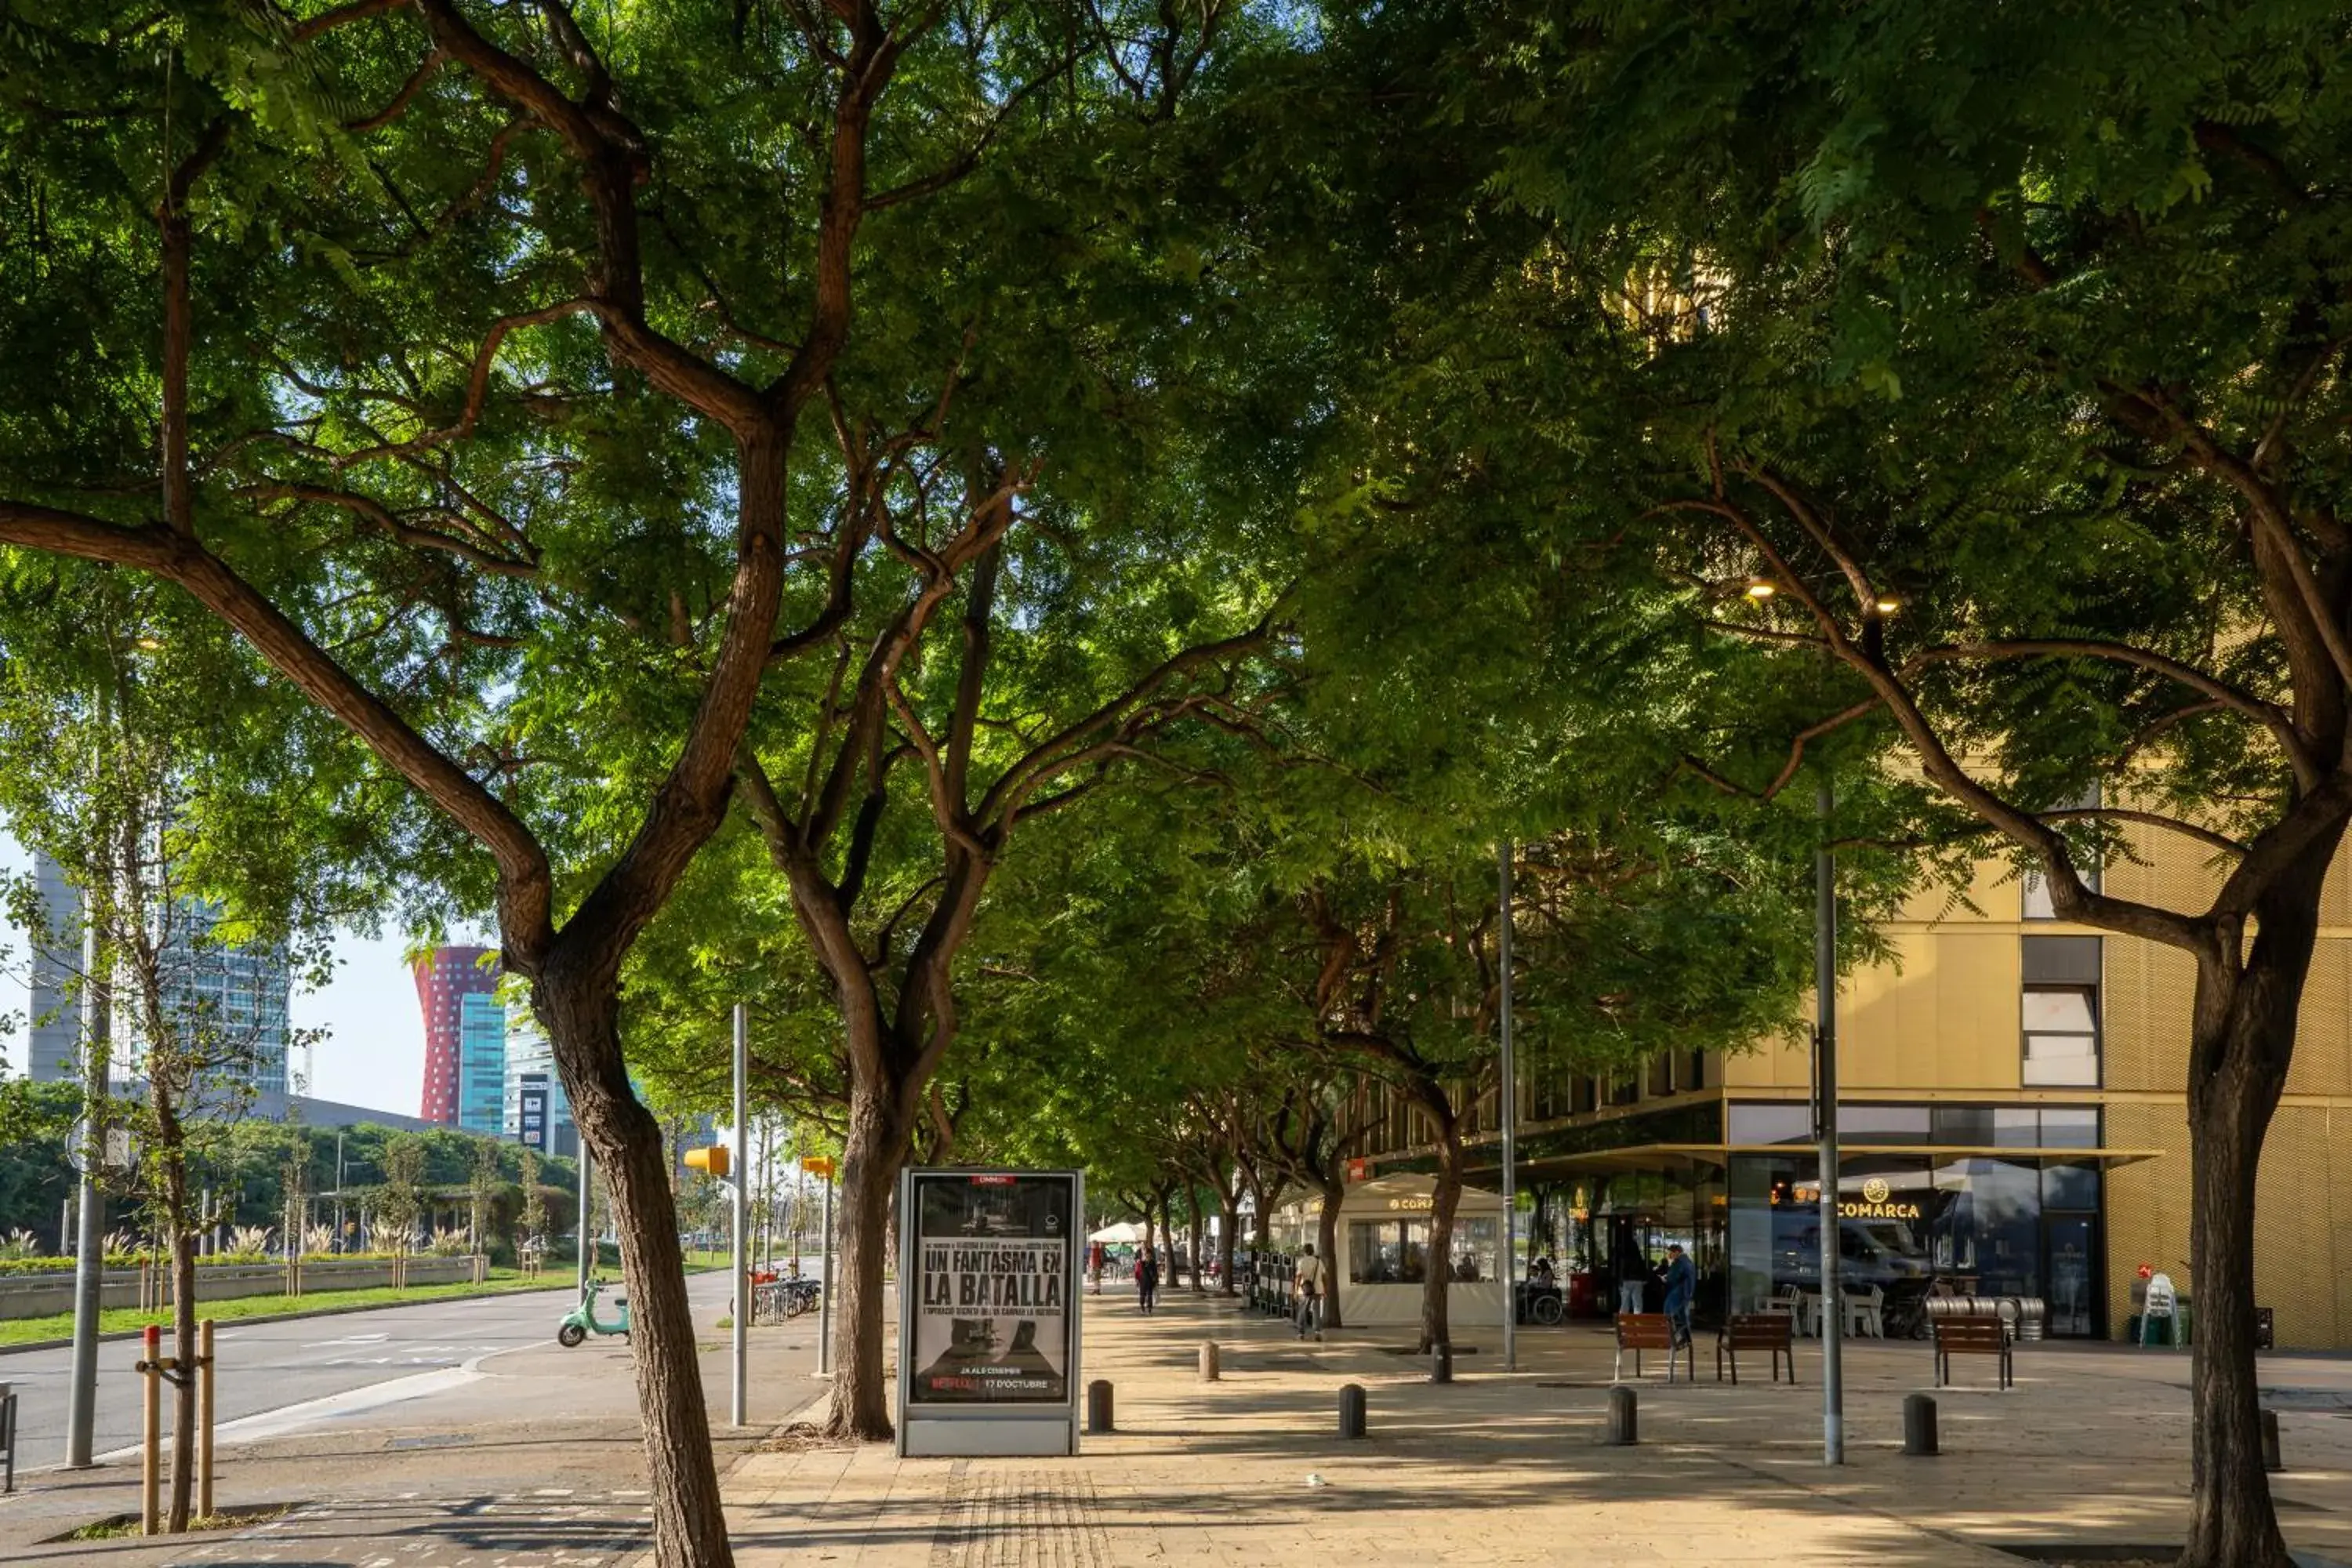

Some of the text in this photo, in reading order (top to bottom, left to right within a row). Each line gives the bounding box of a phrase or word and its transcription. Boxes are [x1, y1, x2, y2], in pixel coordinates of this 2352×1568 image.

[926, 1250, 947, 1272] UN
[953, 1250, 1036, 1272] FANTASMA
[924, 1273, 1061, 1306] LA BATALLA
